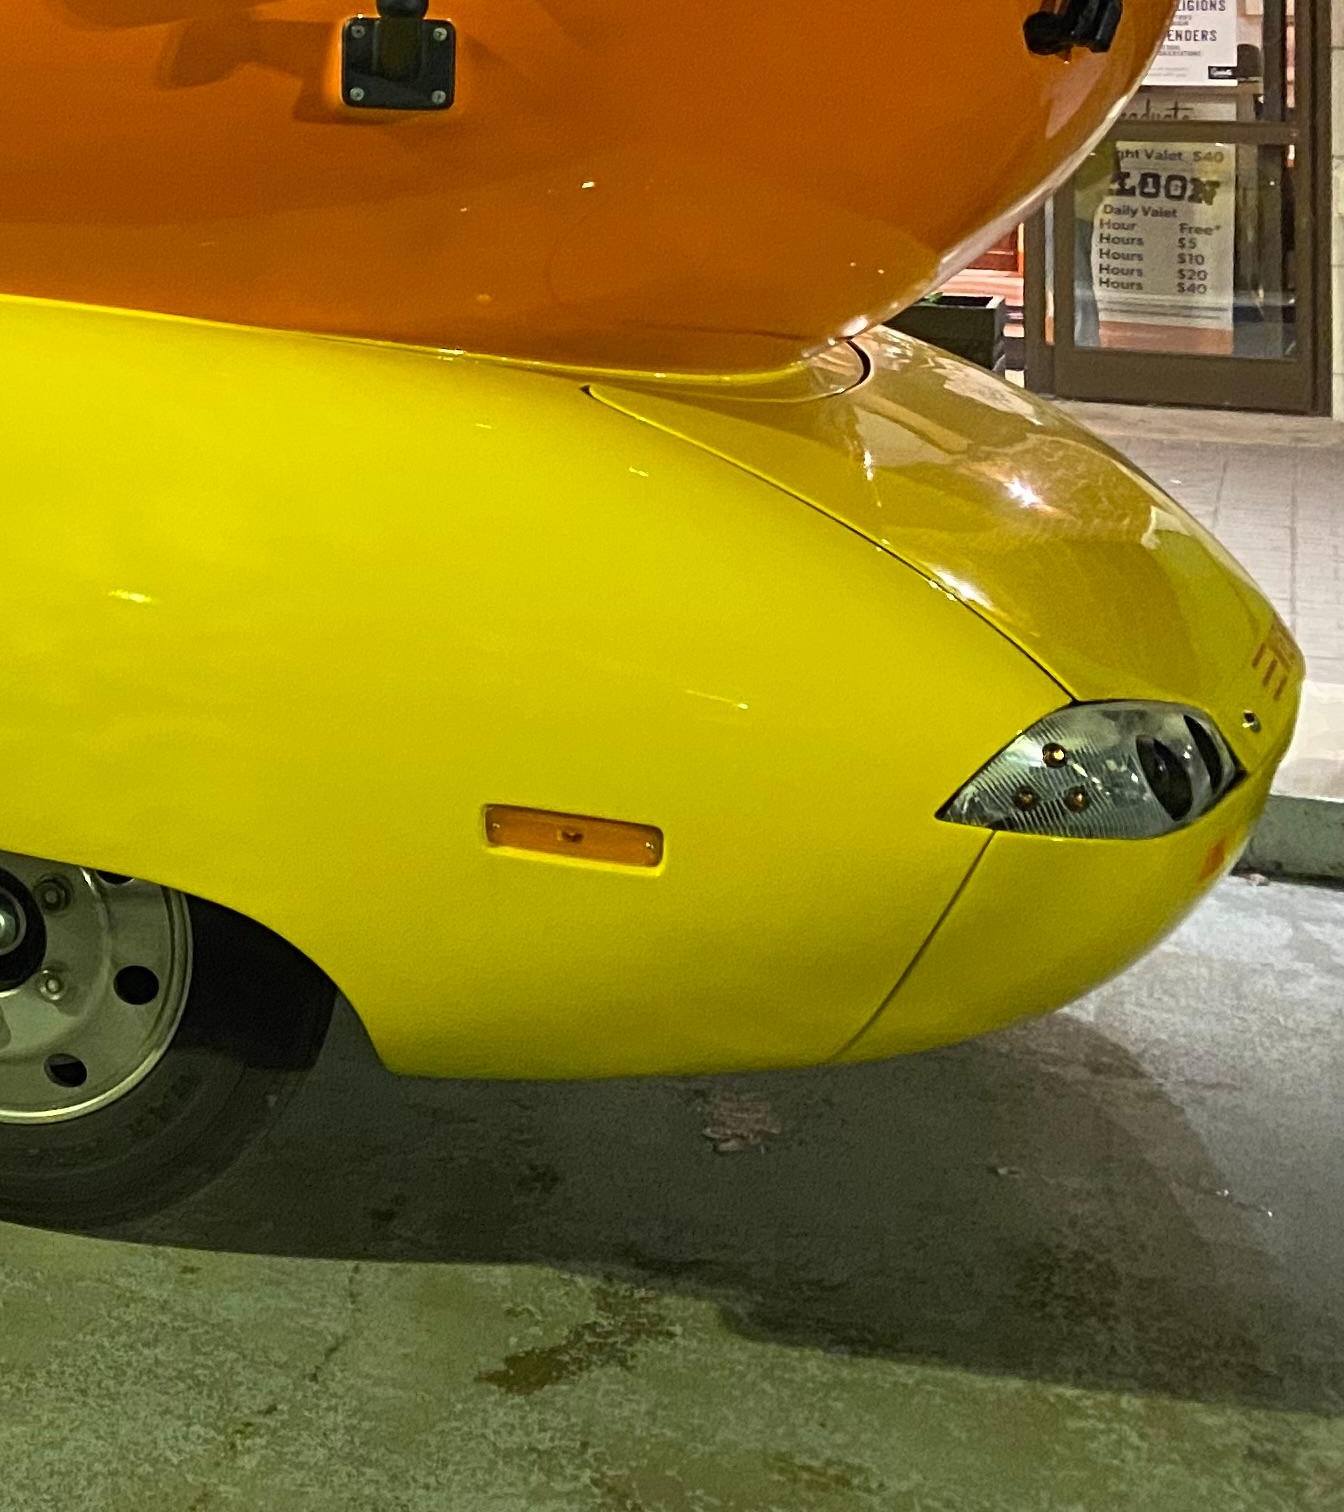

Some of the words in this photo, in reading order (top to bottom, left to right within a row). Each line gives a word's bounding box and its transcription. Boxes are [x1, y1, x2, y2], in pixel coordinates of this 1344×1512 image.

[1167, 29, 1217, 42] ENDERS
[1143, 149, 1184, 161] Valet
[1103, 204, 1138, 218] Daily
[1142, 206, 1178, 218] Valet
[1099, 218, 1137, 231] Hour
[1099, 233, 1144, 246] Hours
[1178, 237, 1197, 250] $5
[1099, 249, 1144, 262] Hours
[1177, 253, 1205, 266] $10
[1099, 263, 1144, 277] Hours
[1177, 268, 1208, 281] $20
[1099, 277, 1144, 290] Hours
[1177, 282, 1208, 294] $40
